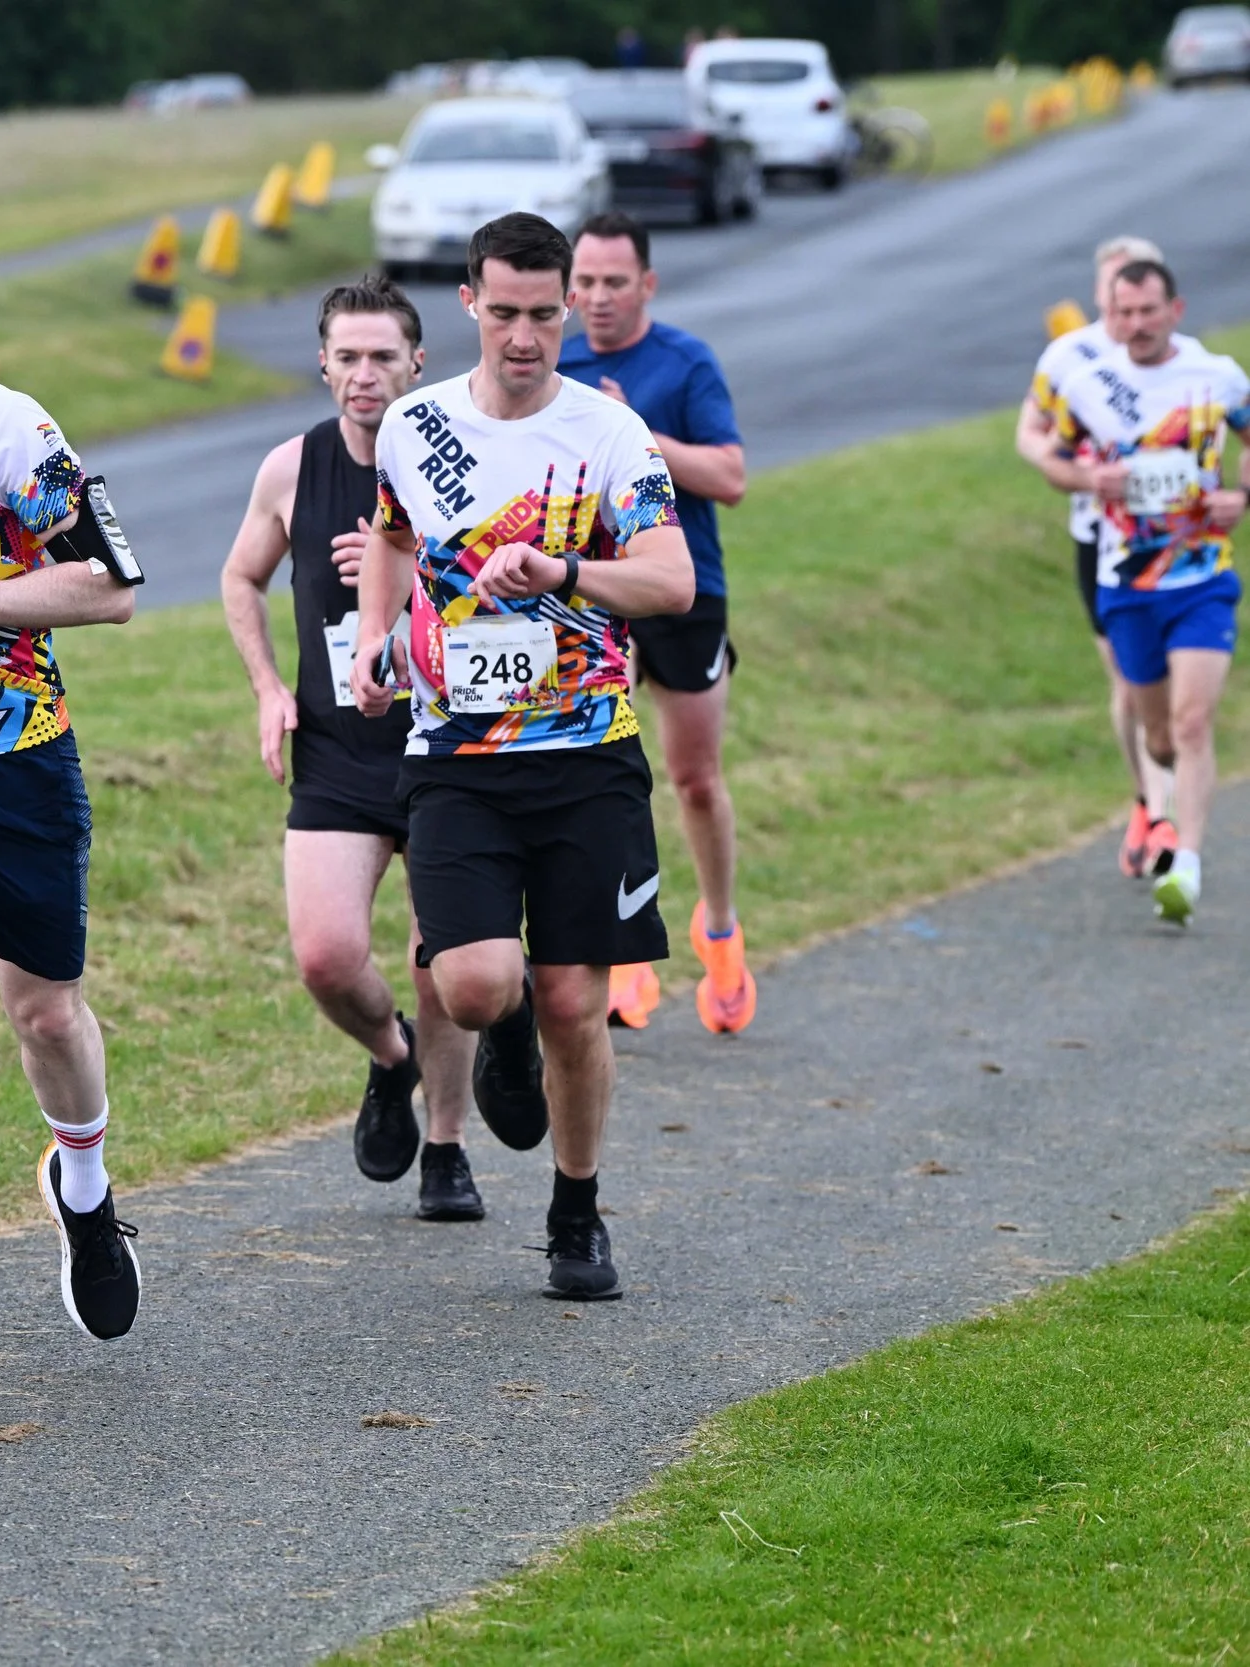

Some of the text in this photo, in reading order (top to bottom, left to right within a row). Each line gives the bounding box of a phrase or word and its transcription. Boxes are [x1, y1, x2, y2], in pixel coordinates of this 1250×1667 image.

[403, 403, 478, 479] PRIDE
[417, 453, 476, 514] RUN
[433, 499, 454, 521] 2024
[469, 652, 533, 686] 248
[452, 687, 477, 695] PRIDE
[464, 694, 483, 702] RUN
